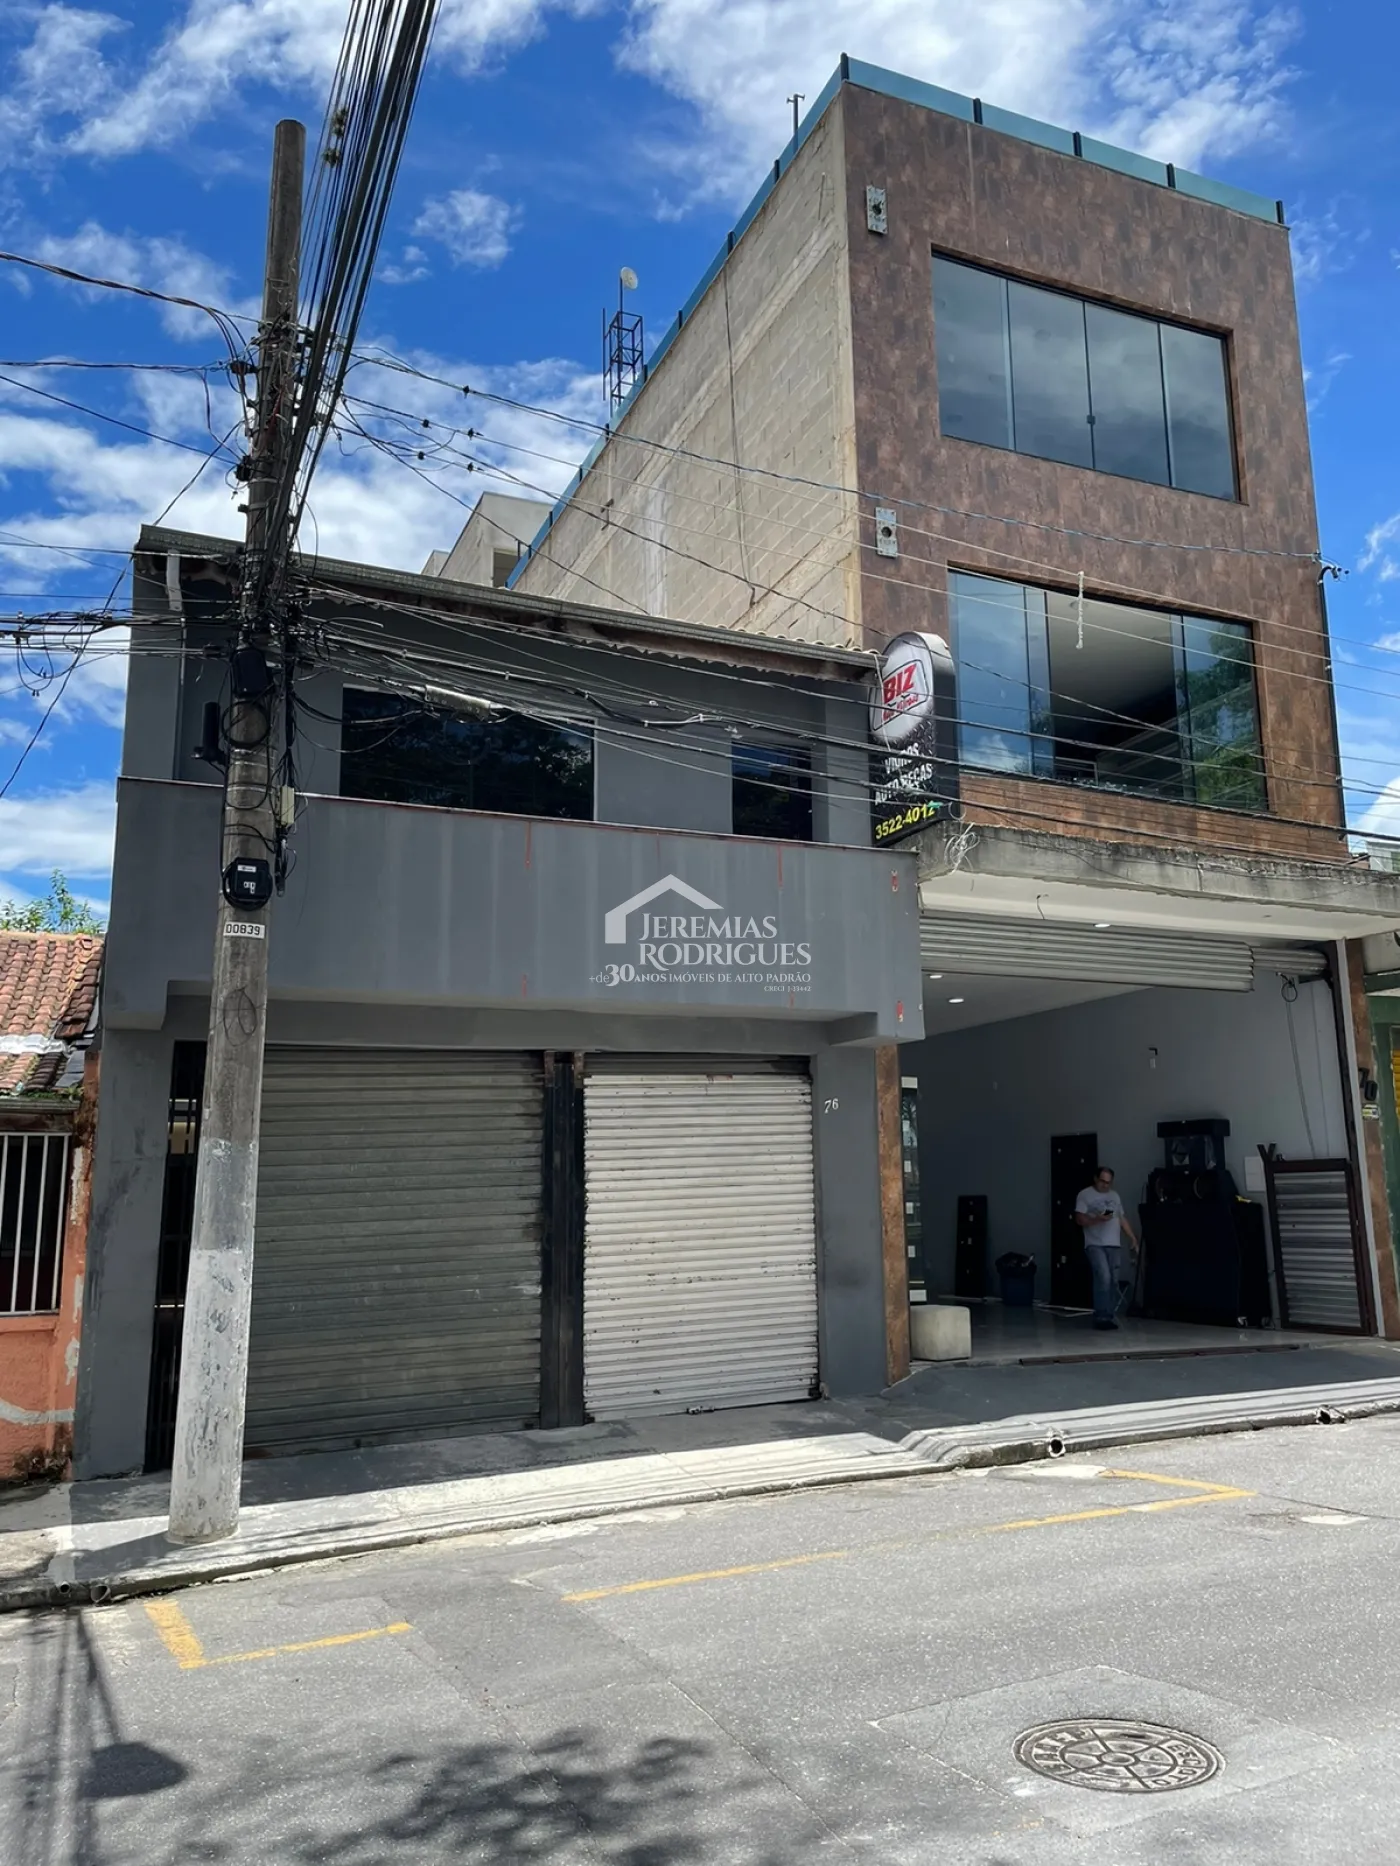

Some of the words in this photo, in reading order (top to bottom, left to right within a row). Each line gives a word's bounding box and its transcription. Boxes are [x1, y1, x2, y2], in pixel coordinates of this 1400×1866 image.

[883, 664, 917, 704] BIZ
[875, 803, 936, 840] 3522-4012
[225, 923, 261, 936] 00839
[824, 1098, 839, 1114] 76
